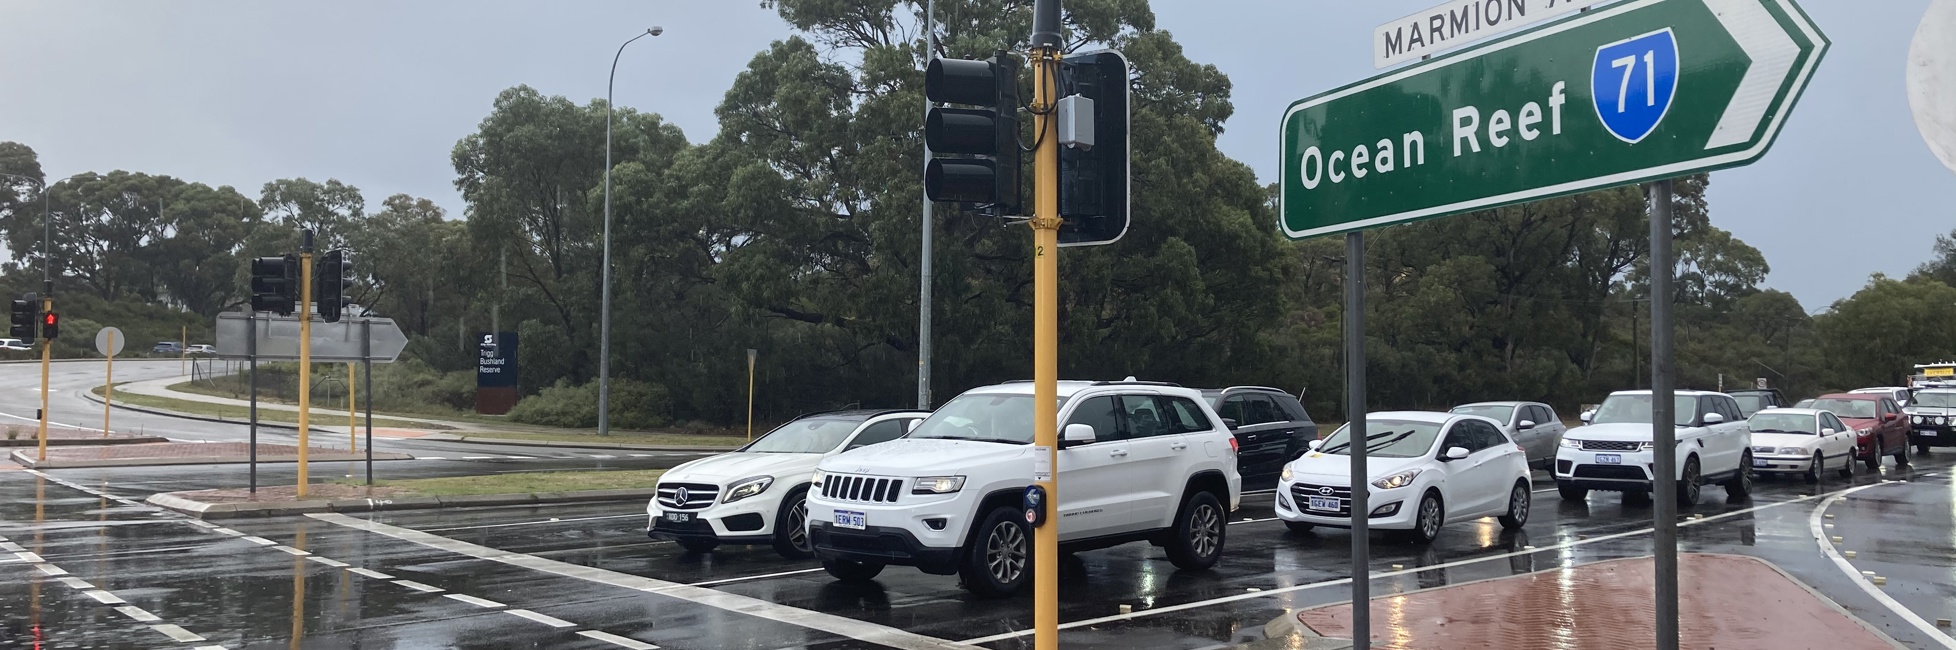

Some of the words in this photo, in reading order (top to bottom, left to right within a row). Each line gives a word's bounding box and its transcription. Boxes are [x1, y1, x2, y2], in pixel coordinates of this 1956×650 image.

[1384, 0, 1525, 58] MARMION
[1611, 49, 1655, 113] 71
[1300, 130, 1425, 190] Ocean
[1452, 80, 1566, 157] Reef
[480, 357, 505, 365] Bushland
[479, 365, 501, 373] Reserve
[679, 513, 689, 521] 156
[853, 516, 864, 527] 503
